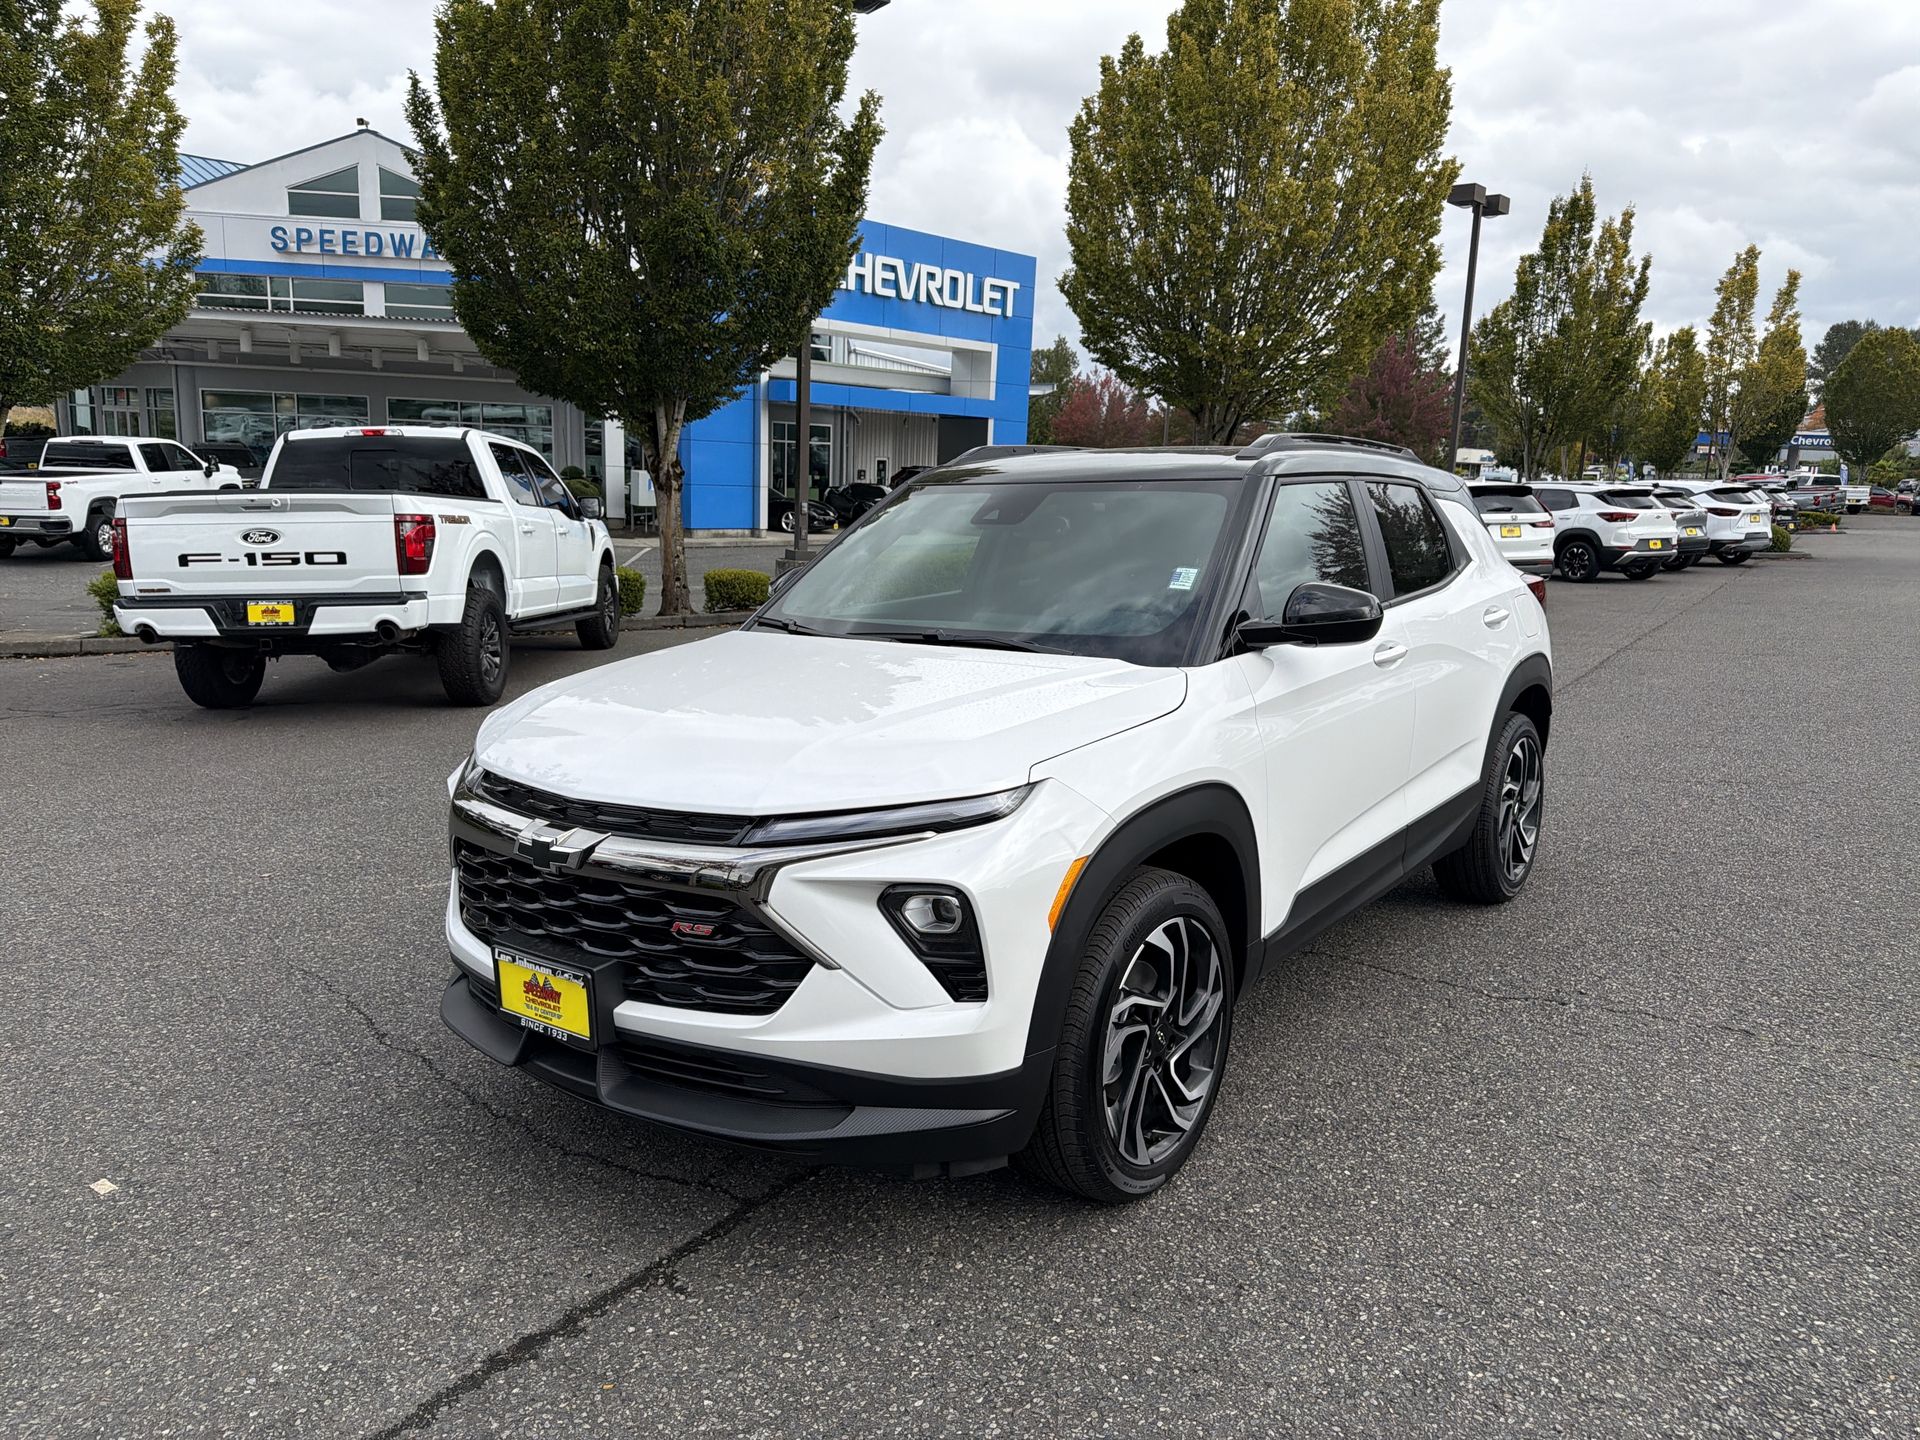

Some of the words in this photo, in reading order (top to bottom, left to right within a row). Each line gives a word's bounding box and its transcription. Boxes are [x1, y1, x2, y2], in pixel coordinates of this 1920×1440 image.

[270, 226, 440, 259] SPEEDWA
[837, 252, 1020, 317] HEVROLET
[247, 530, 274, 543] Ford
[178, 551, 347, 567] F-150
[672, 921, 715, 936] RS
[525, 995, 561, 1012] CHEVROLET
[520, 1018, 544, 1033] SINCE
[547, 1027, 568, 1041] 1933
